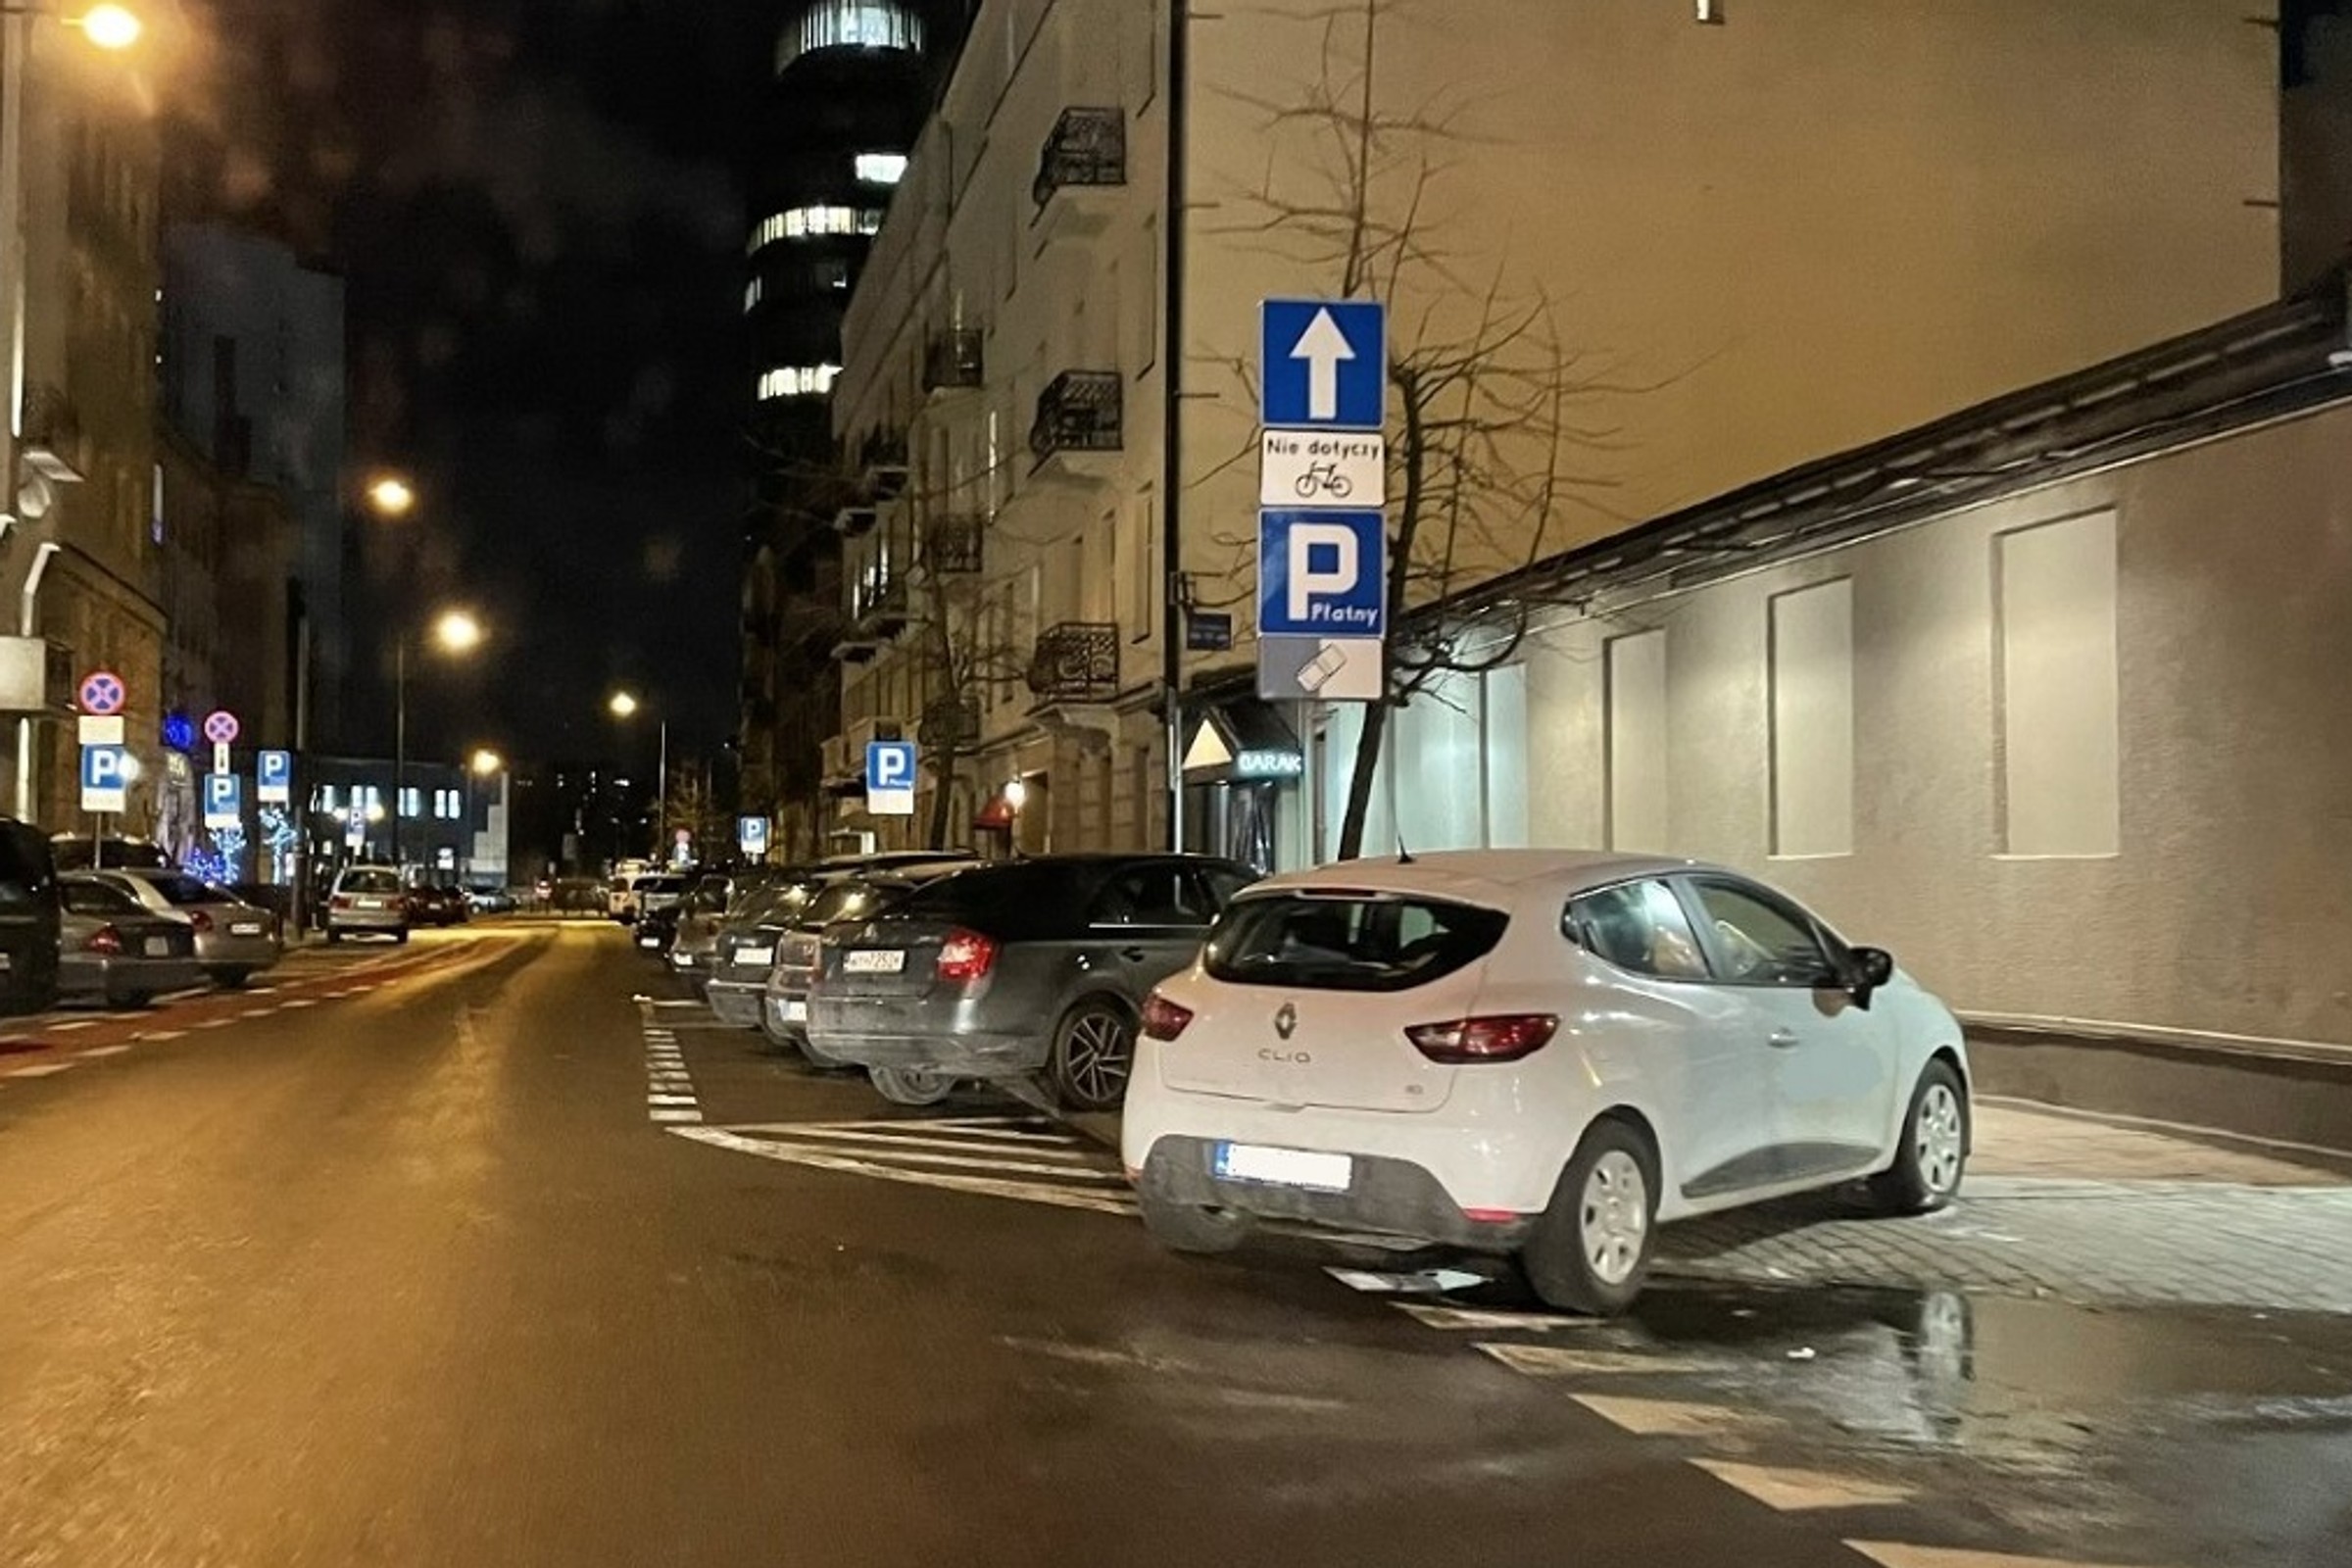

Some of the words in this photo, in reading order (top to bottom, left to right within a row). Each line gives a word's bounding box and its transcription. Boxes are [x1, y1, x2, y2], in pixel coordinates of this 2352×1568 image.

[1267, 438, 1299, 455] Nie
[1307, 439, 1380, 461] dotyczy
[1288, 522, 1359, 621] P
[91, 750, 119, 785] P
[265, 755, 284, 778] P
[878, 748, 906, 786] P
[213, 777, 232, 806] P
[747, 818, 761, 841] P
[1257, 1048, 1311, 1064] CLIO
